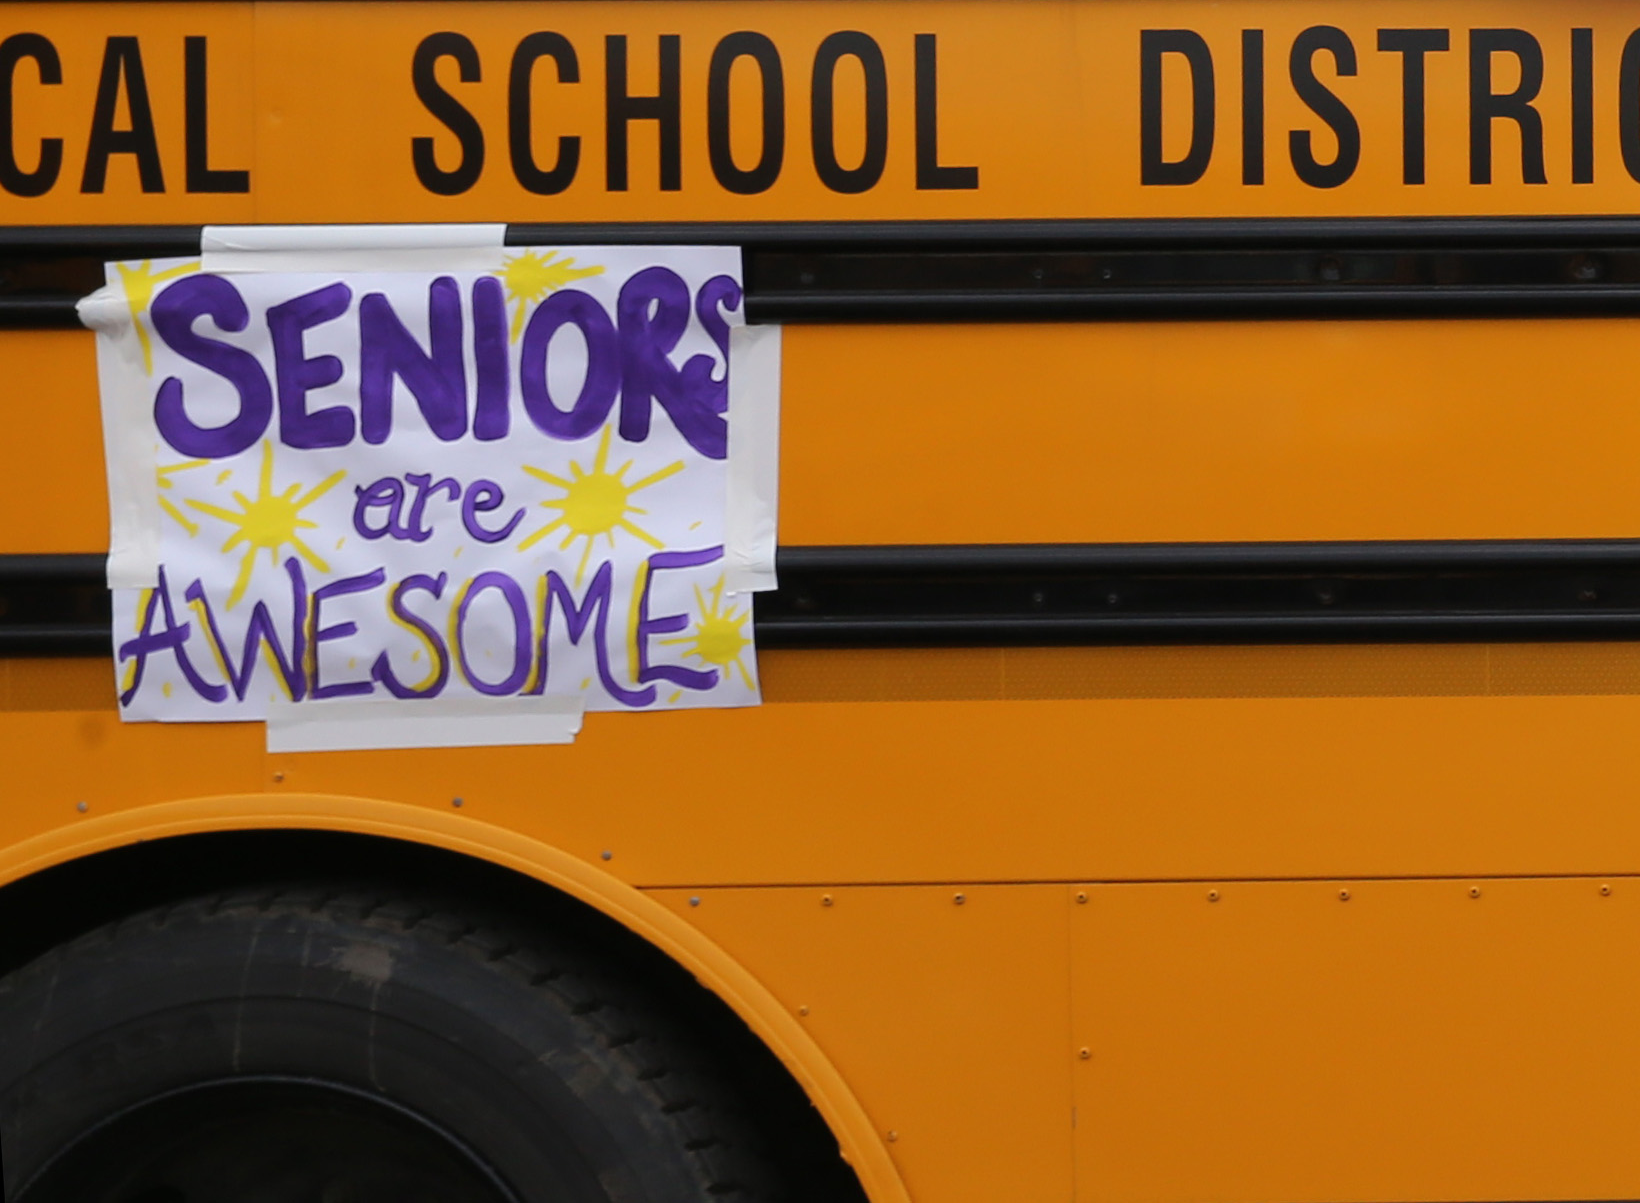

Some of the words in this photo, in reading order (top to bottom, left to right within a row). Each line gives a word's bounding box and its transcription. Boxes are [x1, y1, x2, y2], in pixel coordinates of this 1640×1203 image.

[0, 32, 250, 198] CAL
[411, 29, 979, 196] SCHOOL
[150, 266, 743, 459] SENIORS
[352, 472, 526, 543] are
[119, 545, 724, 708] AWESOME
